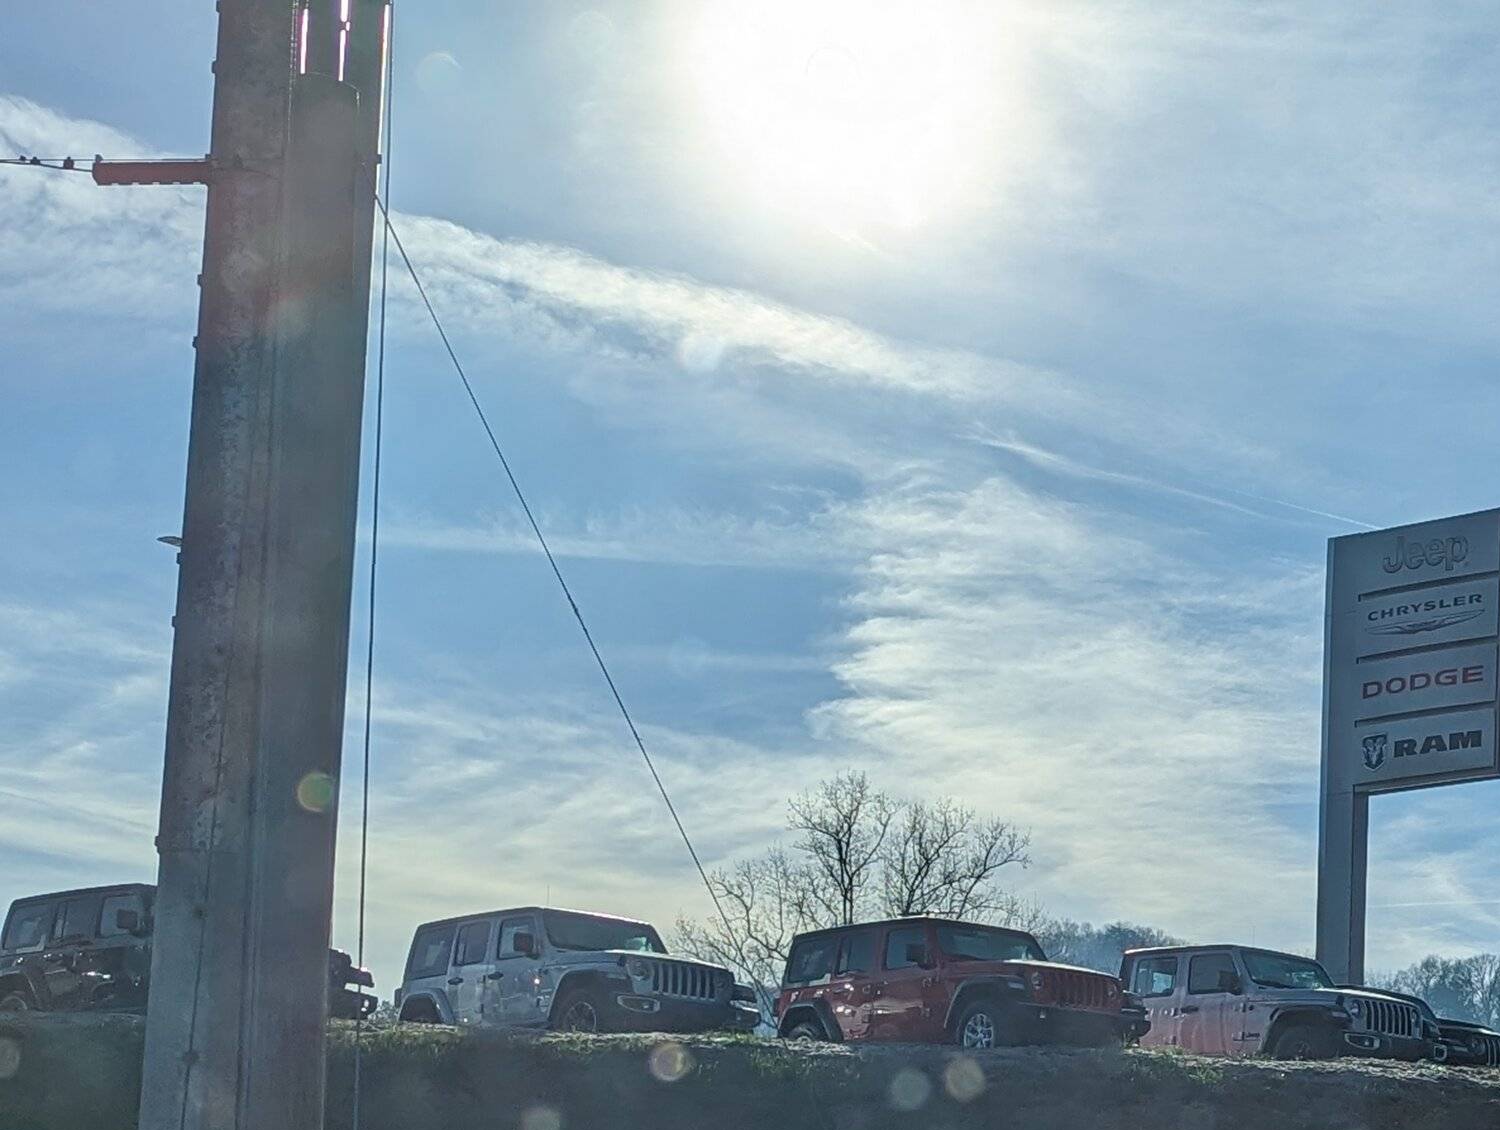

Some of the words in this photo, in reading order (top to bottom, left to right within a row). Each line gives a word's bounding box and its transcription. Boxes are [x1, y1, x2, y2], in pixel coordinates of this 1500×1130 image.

[1382, 535, 1468, 573] Jeep
[1367, 593, 1483, 621] CHRYSLER
[1362, 665, 1484, 699] DODGE
[1393, 730, 1483, 758] RAM
